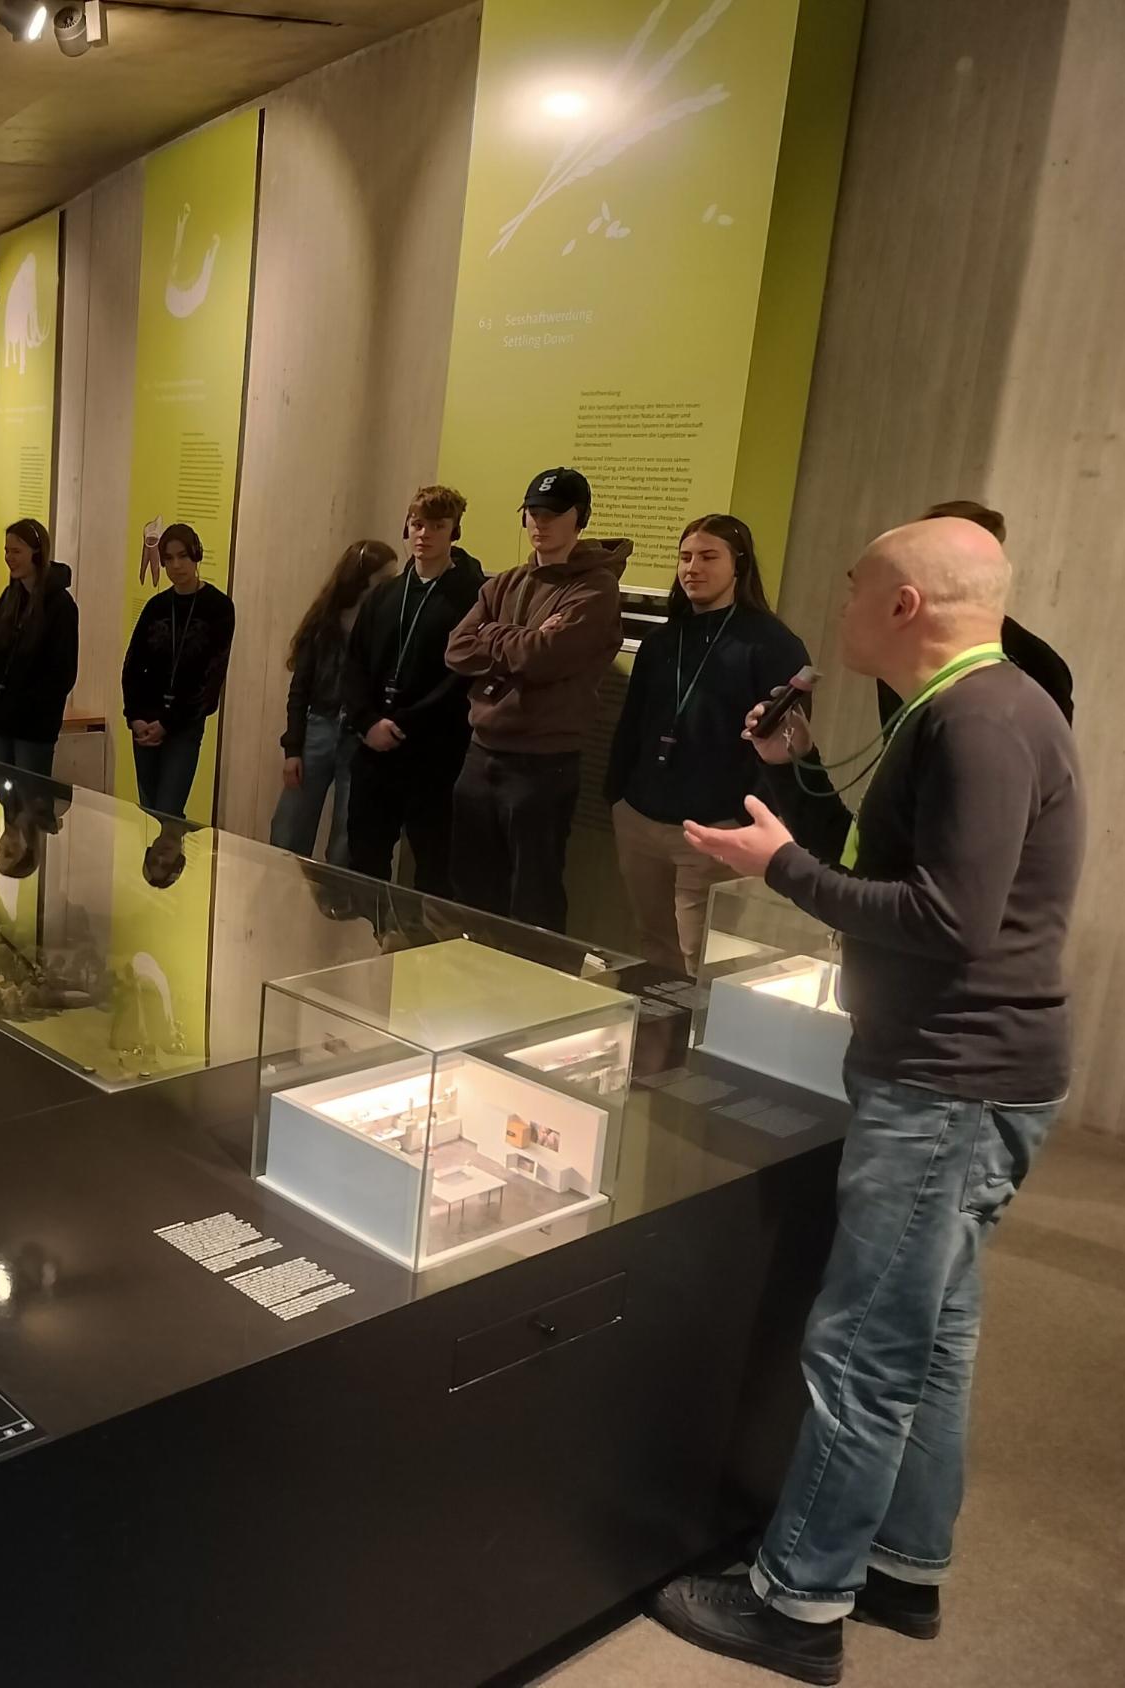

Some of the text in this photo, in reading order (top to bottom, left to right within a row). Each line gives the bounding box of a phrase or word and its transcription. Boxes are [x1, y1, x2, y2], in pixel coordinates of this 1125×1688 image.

[502, 332, 574, 349] Settling Down
[538, 476, 556, 491] g
